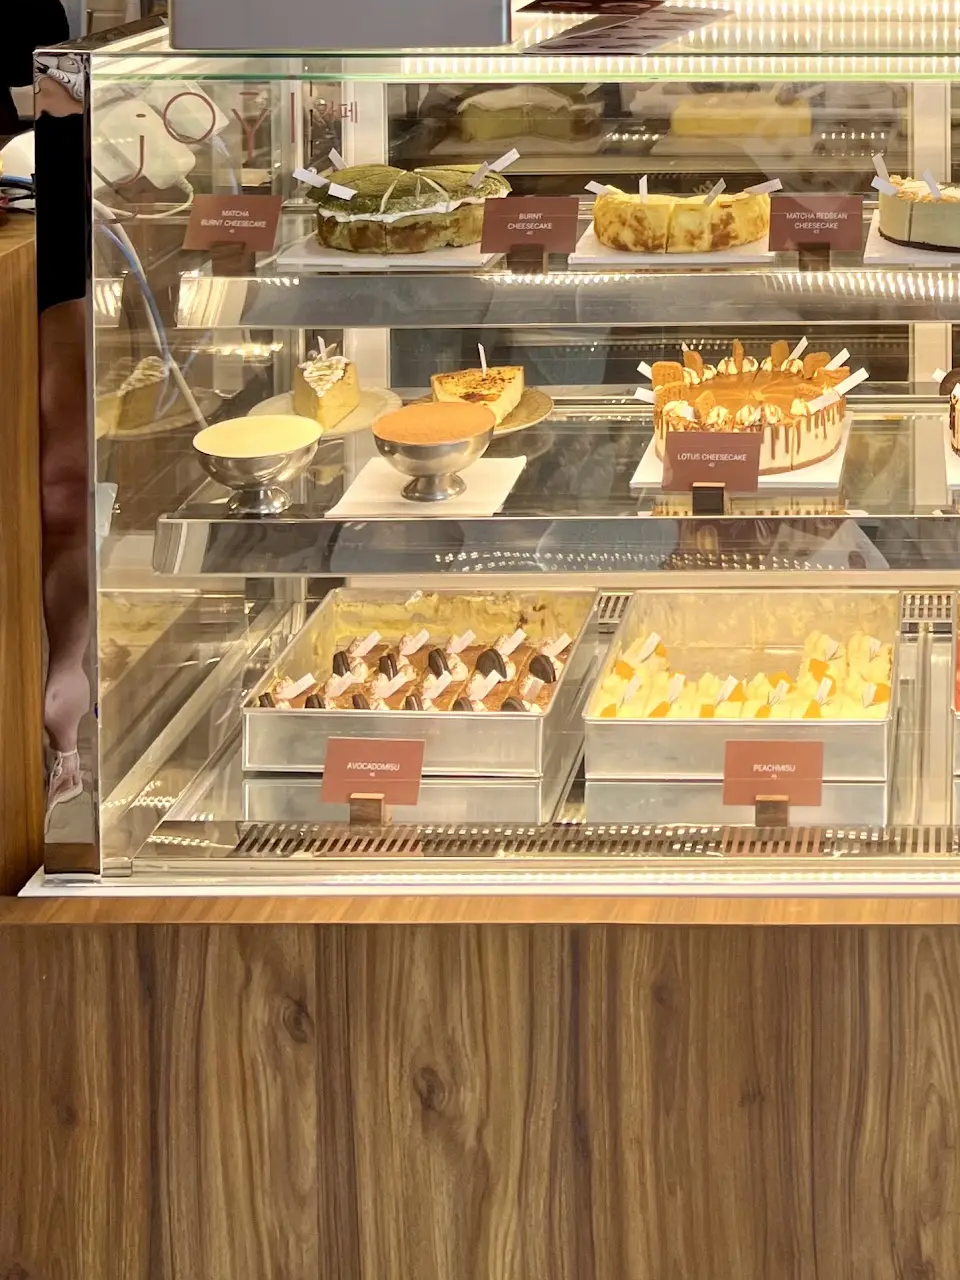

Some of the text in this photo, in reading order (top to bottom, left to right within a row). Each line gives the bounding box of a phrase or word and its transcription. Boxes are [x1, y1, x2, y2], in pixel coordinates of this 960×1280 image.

[518, 212, 543, 220] BURNT
[786, 212, 848, 220] MATCHA REDBEAN
[224, 219, 267, 228] CHEESECAKE
[507, 222, 553, 230] CHEESECAKE
[677, 452, 747, 462] LOTUS CHEESECAKE
[346, 762, 400, 771] AVOCADOMISU
[753, 764, 796, 772] PEACHMISU
